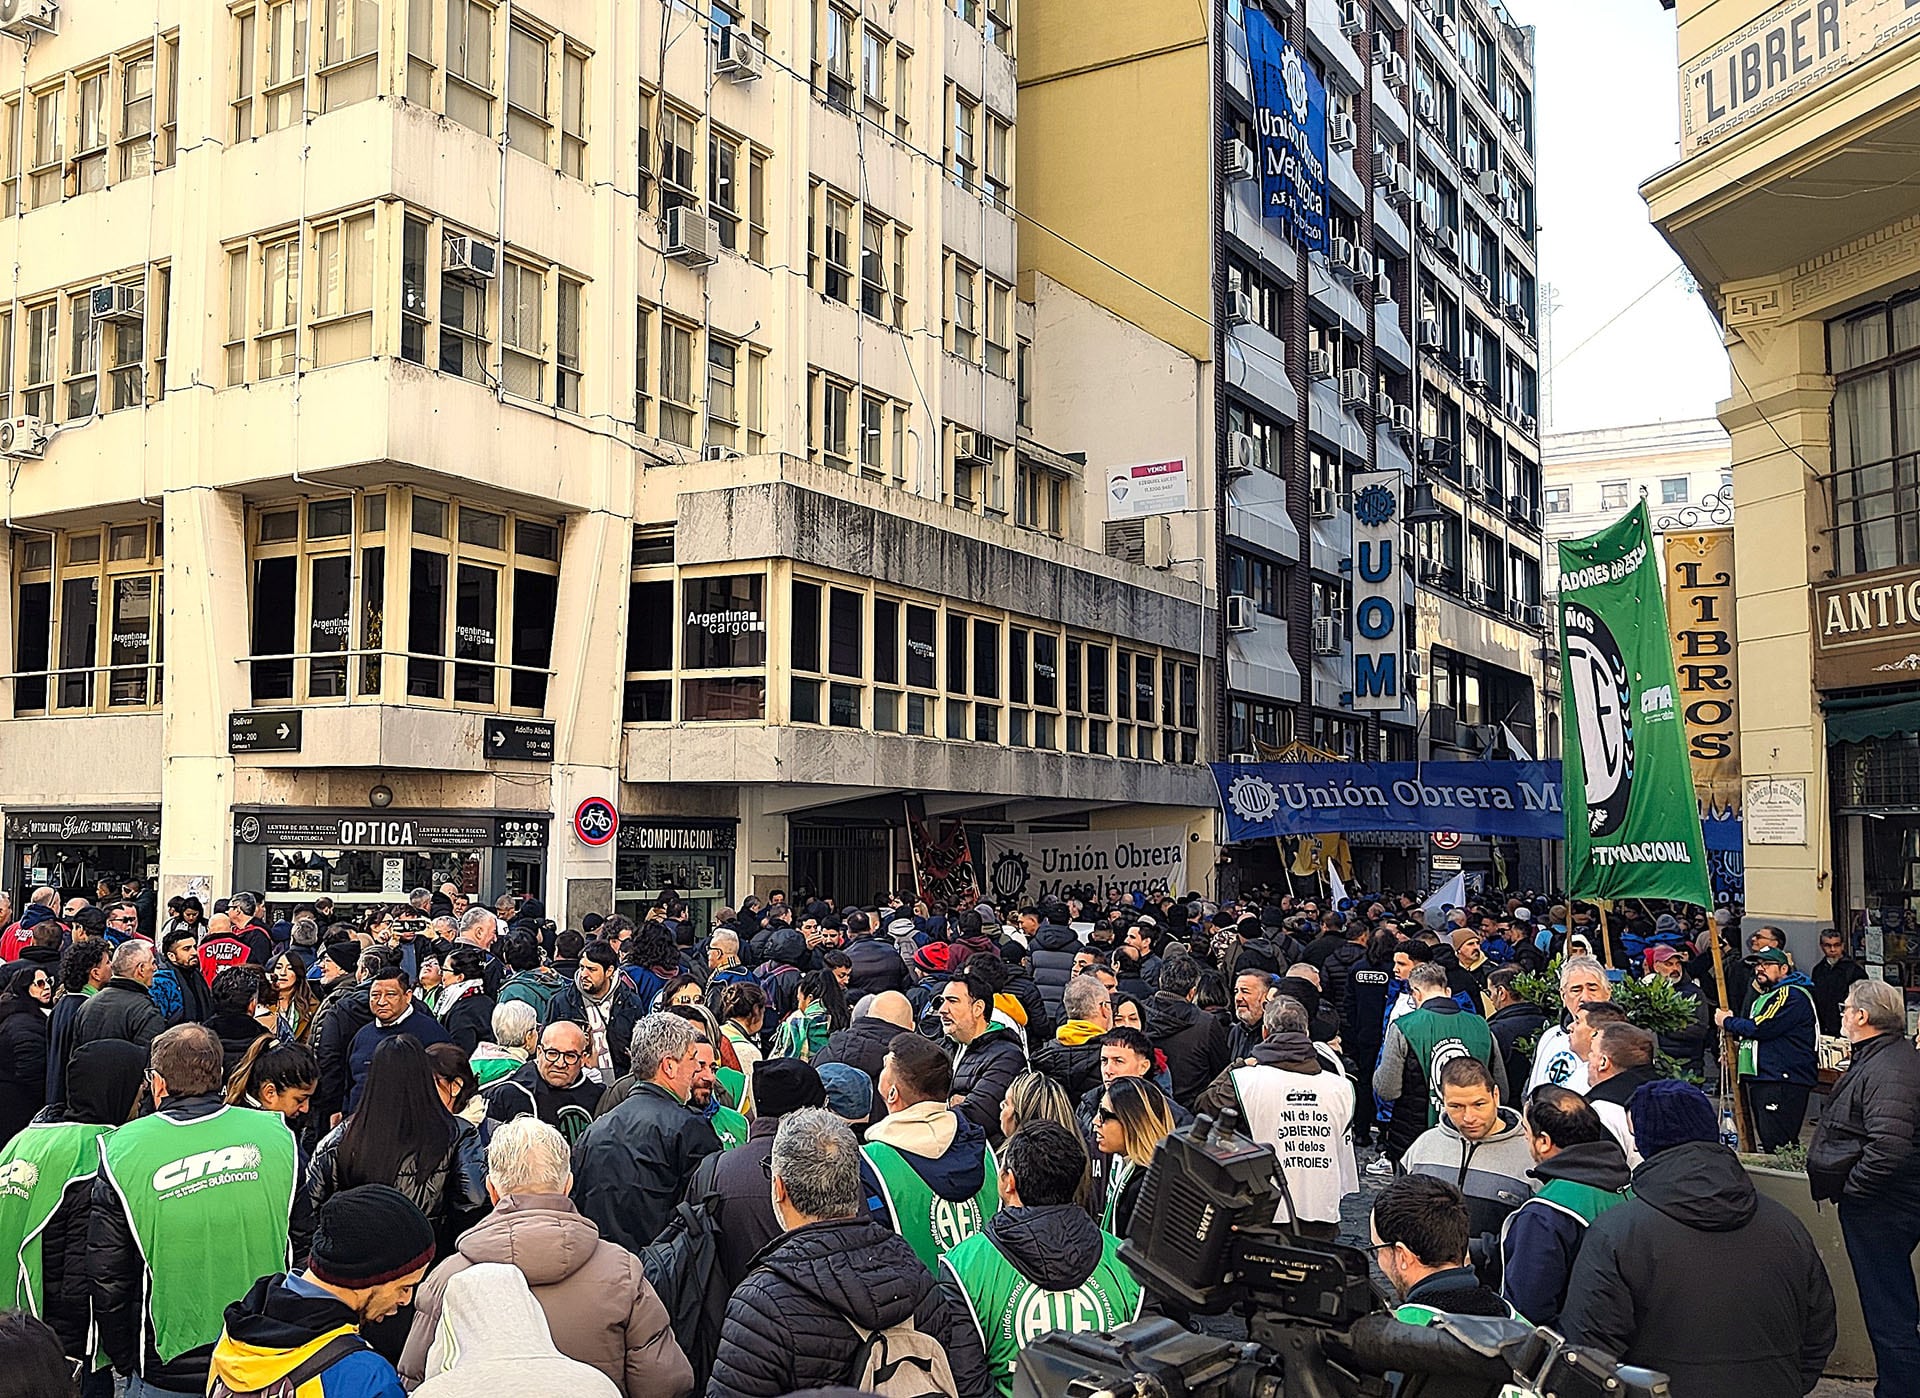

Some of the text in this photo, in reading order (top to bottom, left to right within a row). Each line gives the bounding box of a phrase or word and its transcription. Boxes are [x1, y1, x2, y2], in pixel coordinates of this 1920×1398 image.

[1147, 465, 1167, 473] VENDE
[312, 618, 347, 630] Argentina
[687, 609, 749, 627] Argentina
[1355, 540, 1396, 698] UOM
[325, 626, 348, 636] cargo
[455, 626, 486, 636] rgentina
[709, 621, 749, 636] cargo
[113, 632, 143, 643] Argentina
[464, 634, 486, 645] cargo
[123, 640, 143, 649] cargo
[1675, 562, 1734, 760] LIBROS
[233, 733, 242, 741] 100
[540, 741, 550, 749] 400
[1279, 779, 1566, 812] Unión Obrera M
[91, 822, 111, 832] CENTRO
[112, 822, 132, 833] DIGITAL
[341, 821, 412, 845] OPTICA
[640, 828, 713, 849] COMPUTACION
[1041, 842, 1182, 873] Unión Obrera
[206, 942, 242, 958] SUTEPA
[1358, 973, 1384, 981] BERSA
[1312, 1110, 1328, 1122] los
[1284, 1141, 1295, 1152] Ni
[152, 1145, 243, 1192] CTA
[208, 1171, 259, 1187] autónoma
[1196, 1203, 1215, 1241] SWIT
[1003, 1281, 1025, 1339] Unidos somos
